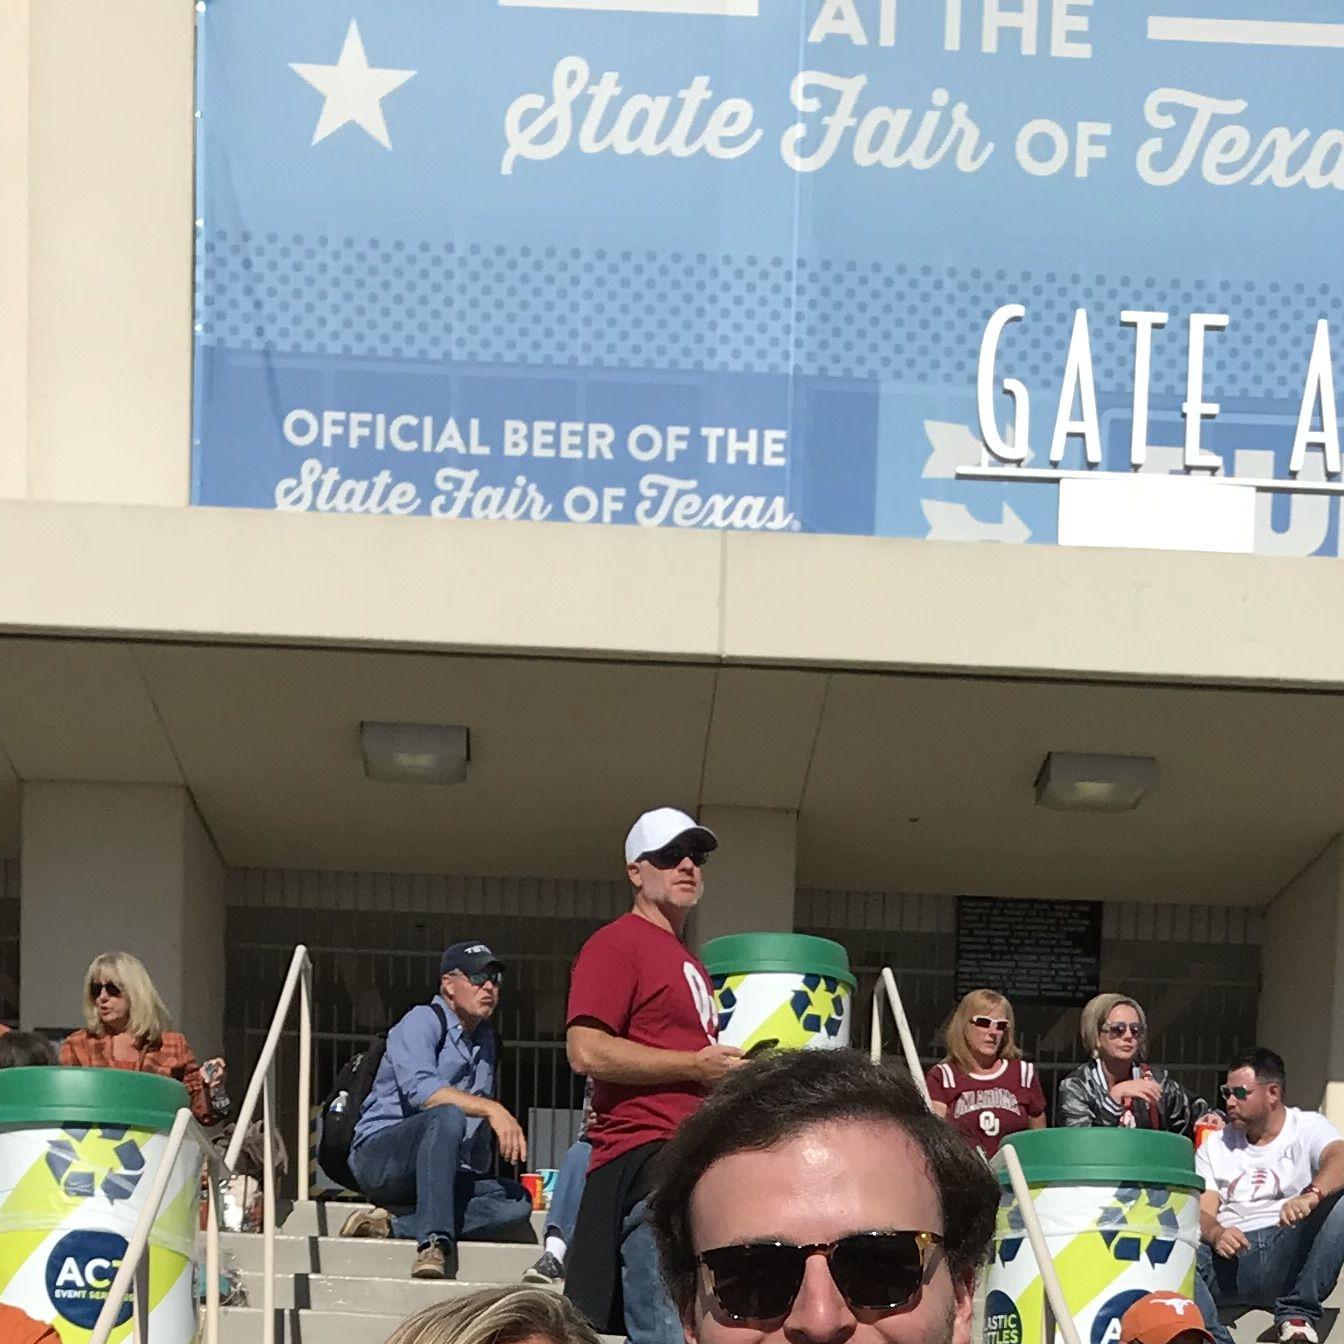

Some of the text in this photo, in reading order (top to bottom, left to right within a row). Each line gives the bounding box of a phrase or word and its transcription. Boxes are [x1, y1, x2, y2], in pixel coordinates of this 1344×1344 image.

[944, 0, 1095, 58] THE
[500, 56, 763, 175] State
[780, 70, 994, 174] Fair
[1014, 119, 1110, 178] OF
[977, 303, 1342, 474] GATE A
[282, 408, 787, 467] OFFICIAL BEER OF THE
[274, 457, 421, 514] State
[430, 467, 553, 520] Fair
[563, 486, 626, 524] OF
